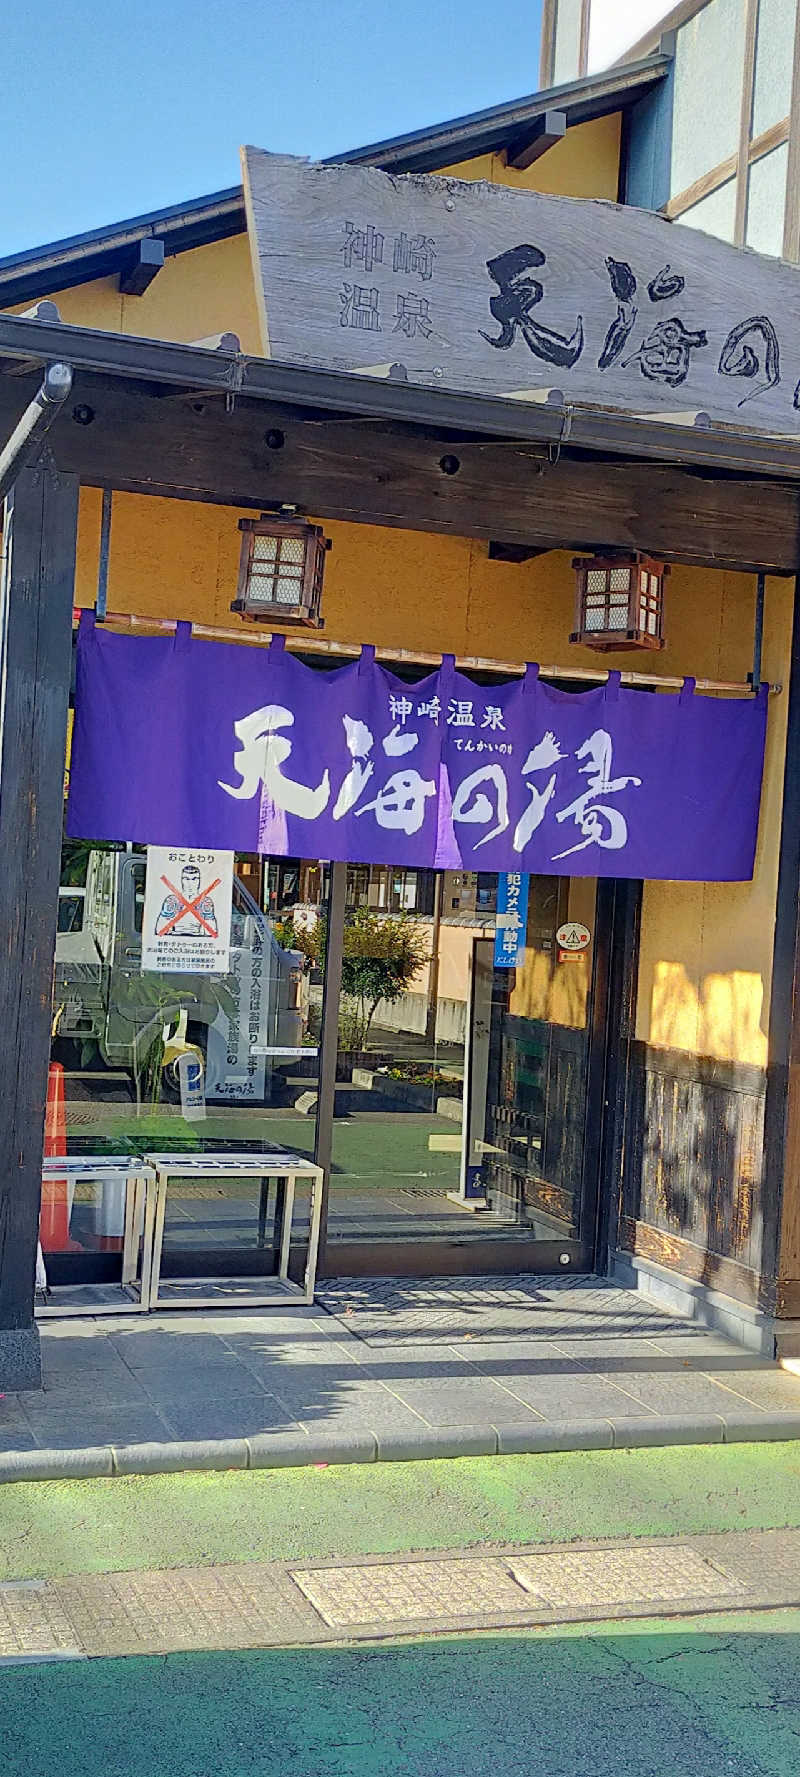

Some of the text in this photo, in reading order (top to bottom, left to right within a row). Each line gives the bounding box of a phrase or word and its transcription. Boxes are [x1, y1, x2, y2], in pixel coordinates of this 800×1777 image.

[339, 221, 438, 281] 神崎
[339, 282, 434, 339] 温泉
[478, 243, 800, 411] 天海の
[389, 694, 507, 732] 神崎温泉
[217, 703, 642, 861] 天海の湯
[168, 852, 215, 864] おことわり
[502, 871, 523, 954] 犯カメ動中
